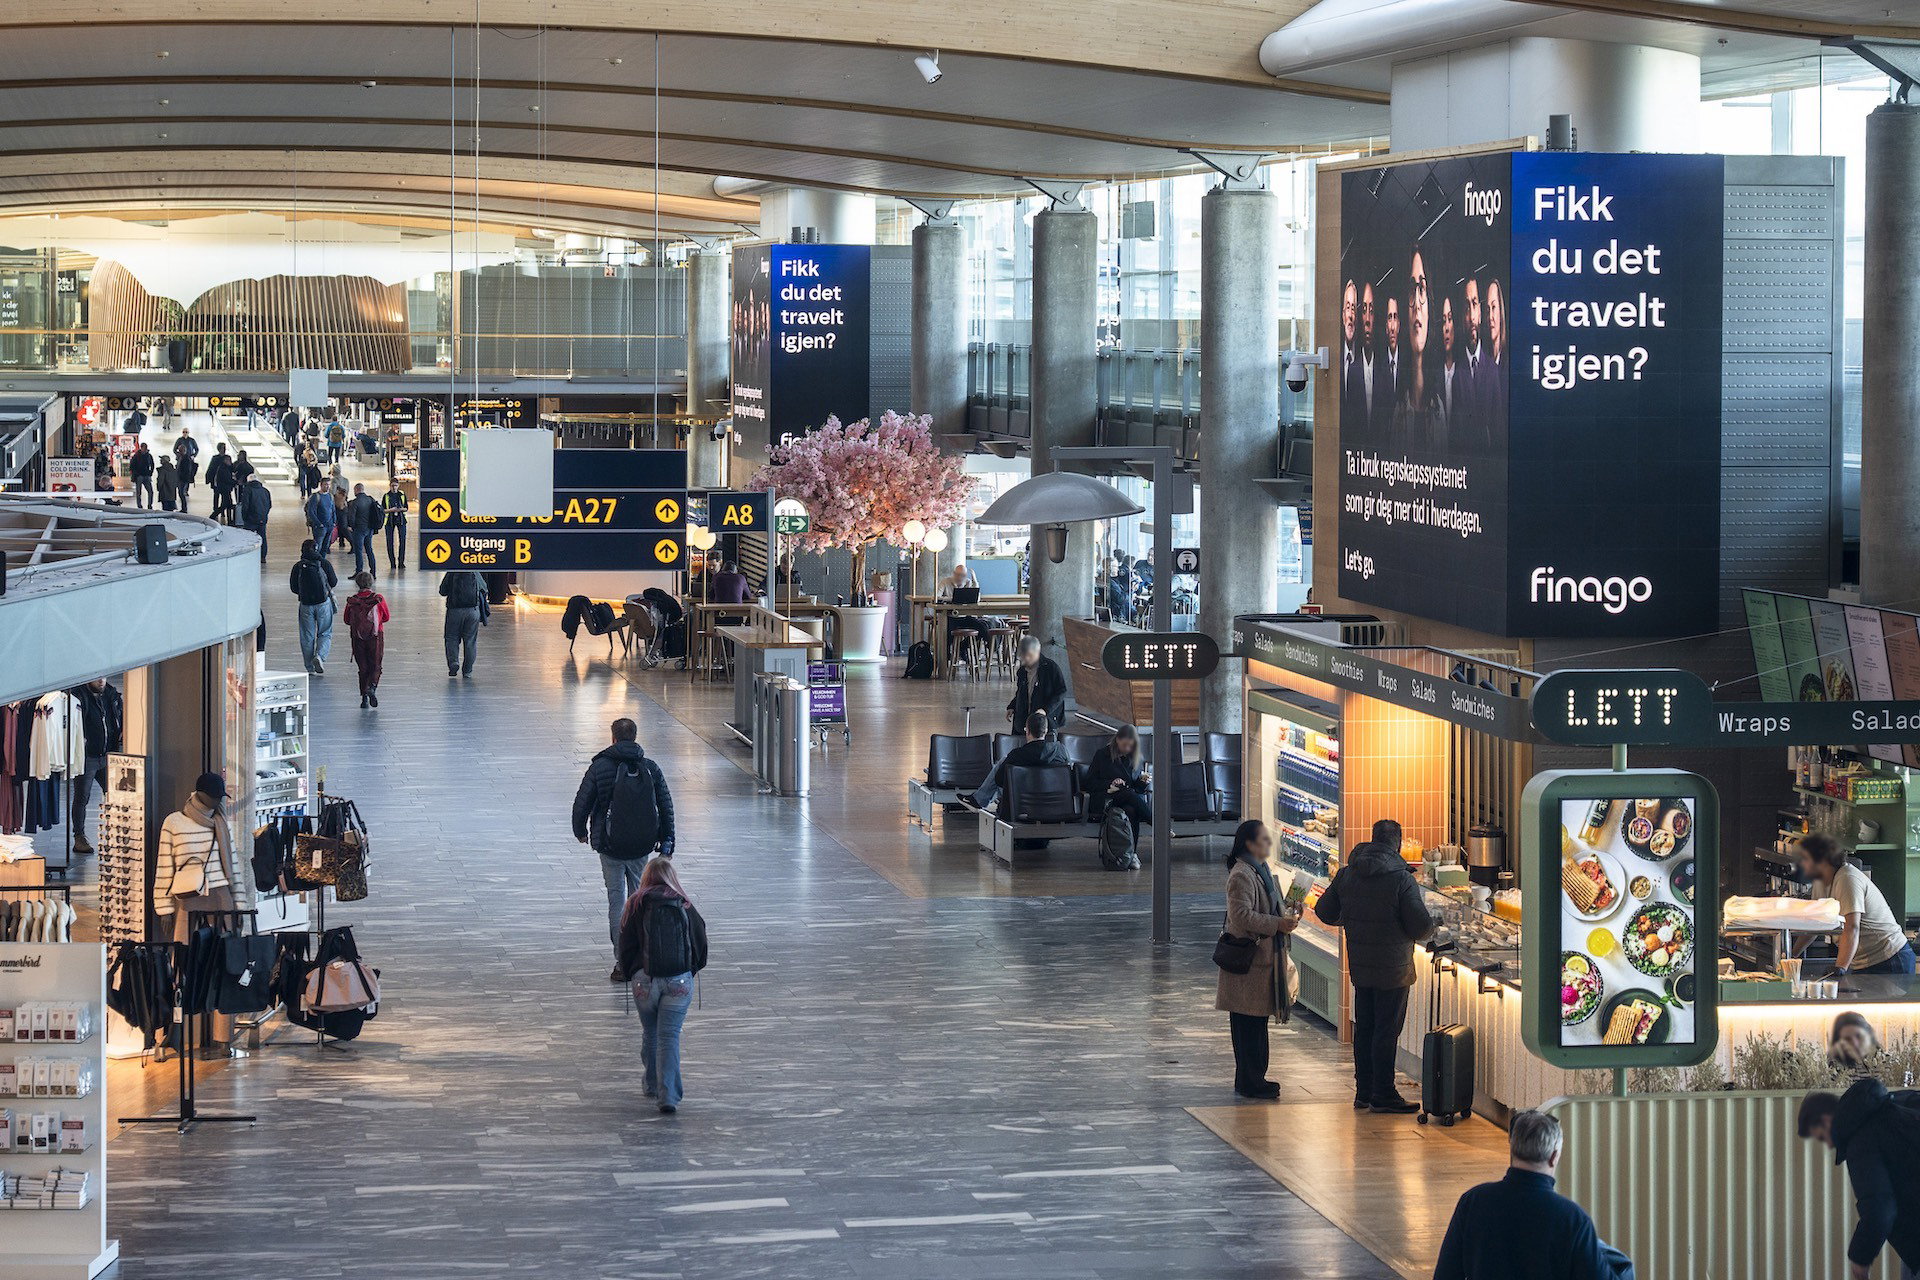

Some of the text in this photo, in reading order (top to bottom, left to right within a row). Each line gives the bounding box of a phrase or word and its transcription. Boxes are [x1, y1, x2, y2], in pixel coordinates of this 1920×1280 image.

[1464, 181, 1501, 227] finago
[1534, 185, 1615, 222] Fikk
[781, 259, 820, 277] Fikk
[1532, 238, 1661, 275] du det
[780, 283, 842, 301] du det
[780, 308, 844, 325] travelt
[1531, 292, 1666, 328] travelt
[780, 331, 837, 353] igjen?
[1532, 344, 1649, 390] igjen?
[1345, 450, 1467, 491] Ta i bruk regnskapssystemet
[516, 498, 617, 523] -A27
[722, 504, 754, 526] A8
[1345, 491, 1482, 538] som gir deg mer tid i hverdagen.
[460, 536, 506, 551] Utgang
[460, 551, 496, 564] Gates
[514, 539, 531, 563] B
[1344, 547, 1375, 580] Let's go.
[1530, 566, 1653, 614] finago
[1125, 644, 1197, 668] LETT
[1254, 632, 1274, 653] Salads
[1285, 641, 1318, 667] Sandwiches
[1331, 656, 1364, 682] Smoothies
[1377, 669, 1398, 694] Wraps
[1411, 678, 1436, 703] Salads
[1451, 690, 1495, 721] Sandwiches
[1567, 688, 1678, 726] LETT
[1718, 712, 1791, 737] Wraps
